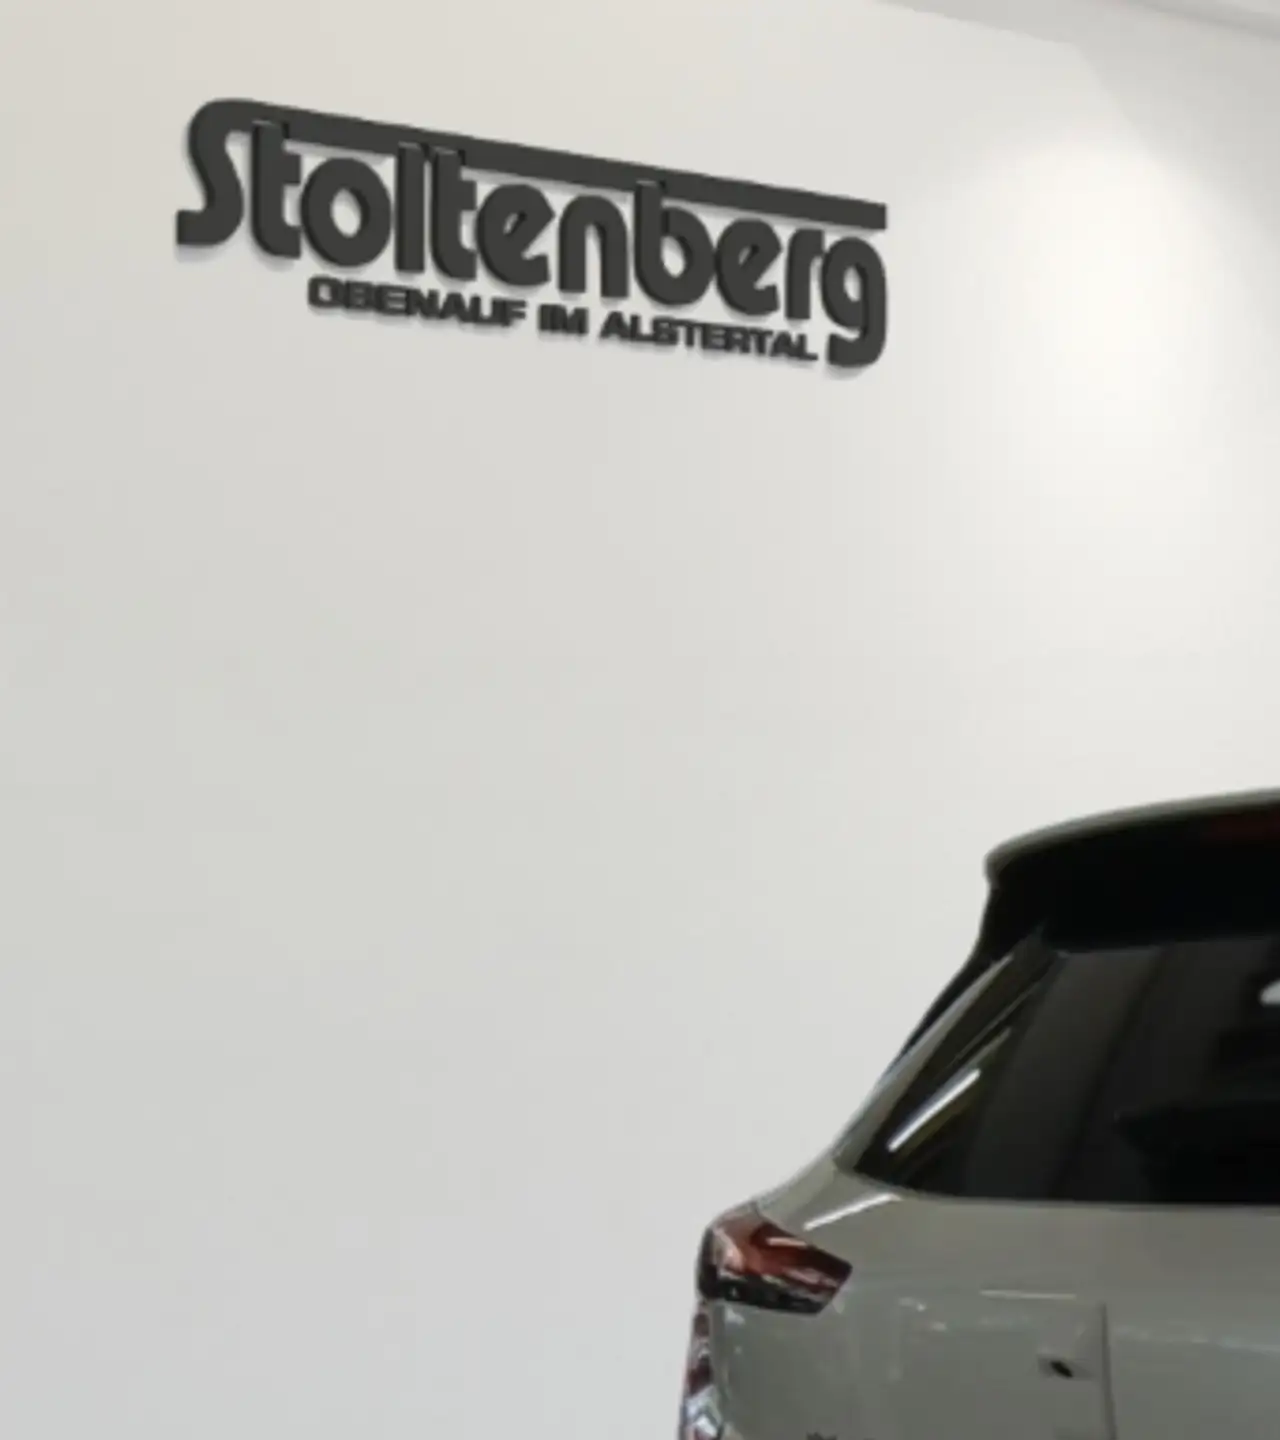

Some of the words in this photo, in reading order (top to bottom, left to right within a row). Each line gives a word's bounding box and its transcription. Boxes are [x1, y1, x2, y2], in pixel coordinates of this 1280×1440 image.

[176, 99, 887, 369] Stoltenberg
[307, 276, 527, 328] OBENAUF
[537, 303, 589, 337] IM
[599, 311, 819, 362] ALSTERTAL
